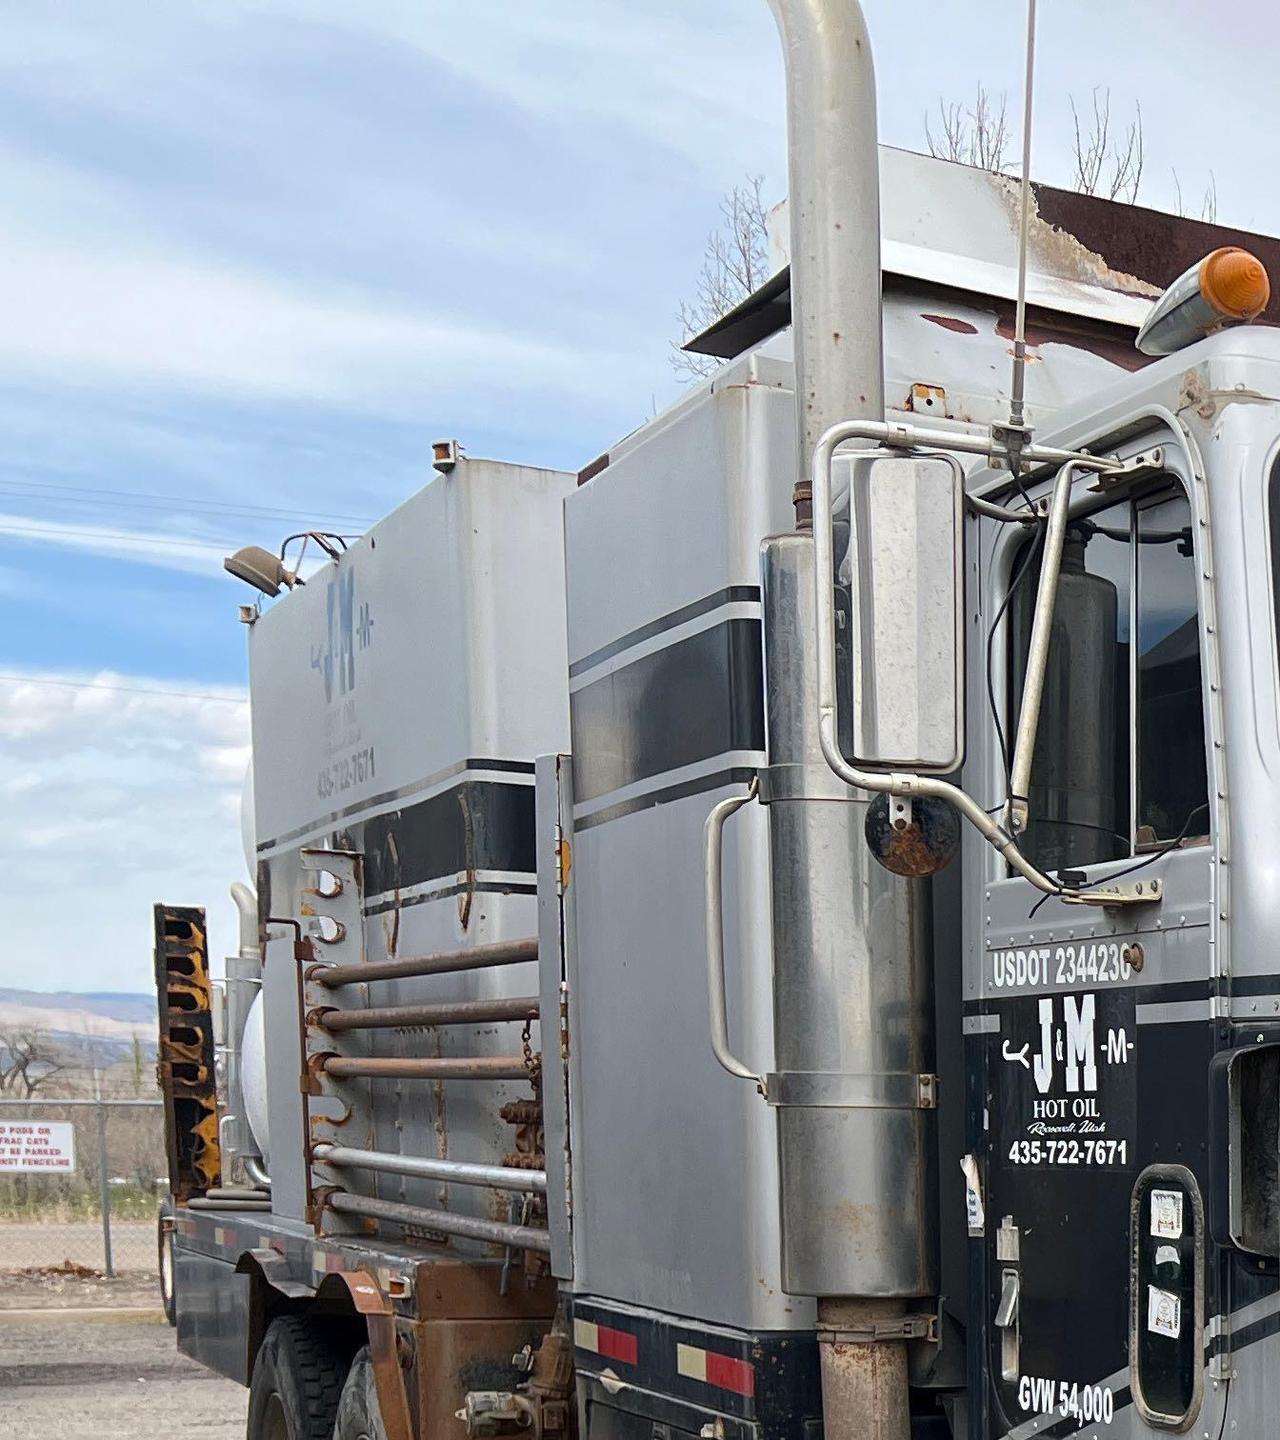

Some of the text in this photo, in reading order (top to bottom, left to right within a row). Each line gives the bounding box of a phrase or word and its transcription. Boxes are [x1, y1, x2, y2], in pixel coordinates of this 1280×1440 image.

[993, 949, 1051, 987] USDOT
[1032, 1098, 1101, 1119] HOT OIL
[1078, 1119, 1106, 1134] Utah
[1008, 1139, 1127, 1165] 435-722-7671
[1018, 1375, 1114, 1428] GVW 54,000
